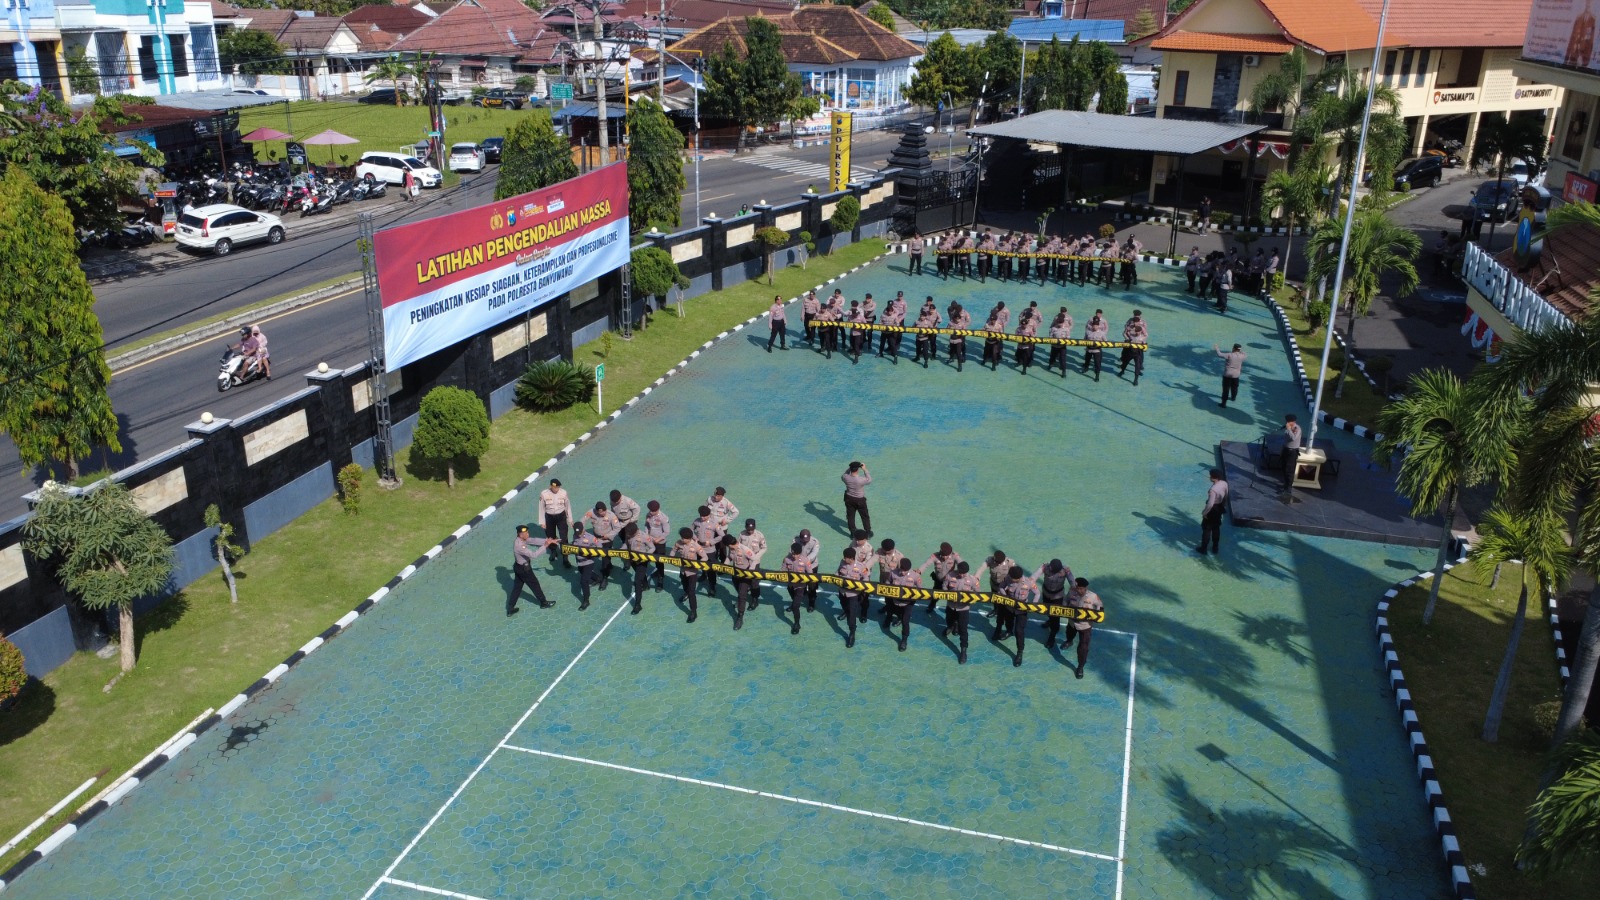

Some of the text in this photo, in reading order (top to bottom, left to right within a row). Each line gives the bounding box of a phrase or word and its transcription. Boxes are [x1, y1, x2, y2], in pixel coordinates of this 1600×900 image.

[1440, 92, 1475, 103] SATSAMAPTA
[833, 127, 842, 192] POLRESTA
[416, 199, 612, 285] LATIHAN PENGENDALIAN MASSA
[410, 230, 618, 325] PENINGKATAN KESIAP SIAGAAN, KETERAMPILAN DAN PROFESIONALISME
[488, 294, 506, 312] PADA
[507, 280, 537, 303] POLRESTA
[538, 265, 574, 290] BANYUWANGI
[878, 585, 899, 597] POLISI
[935, 592, 957, 603] POLISI
[1051, 607, 1073, 617] POLISI
